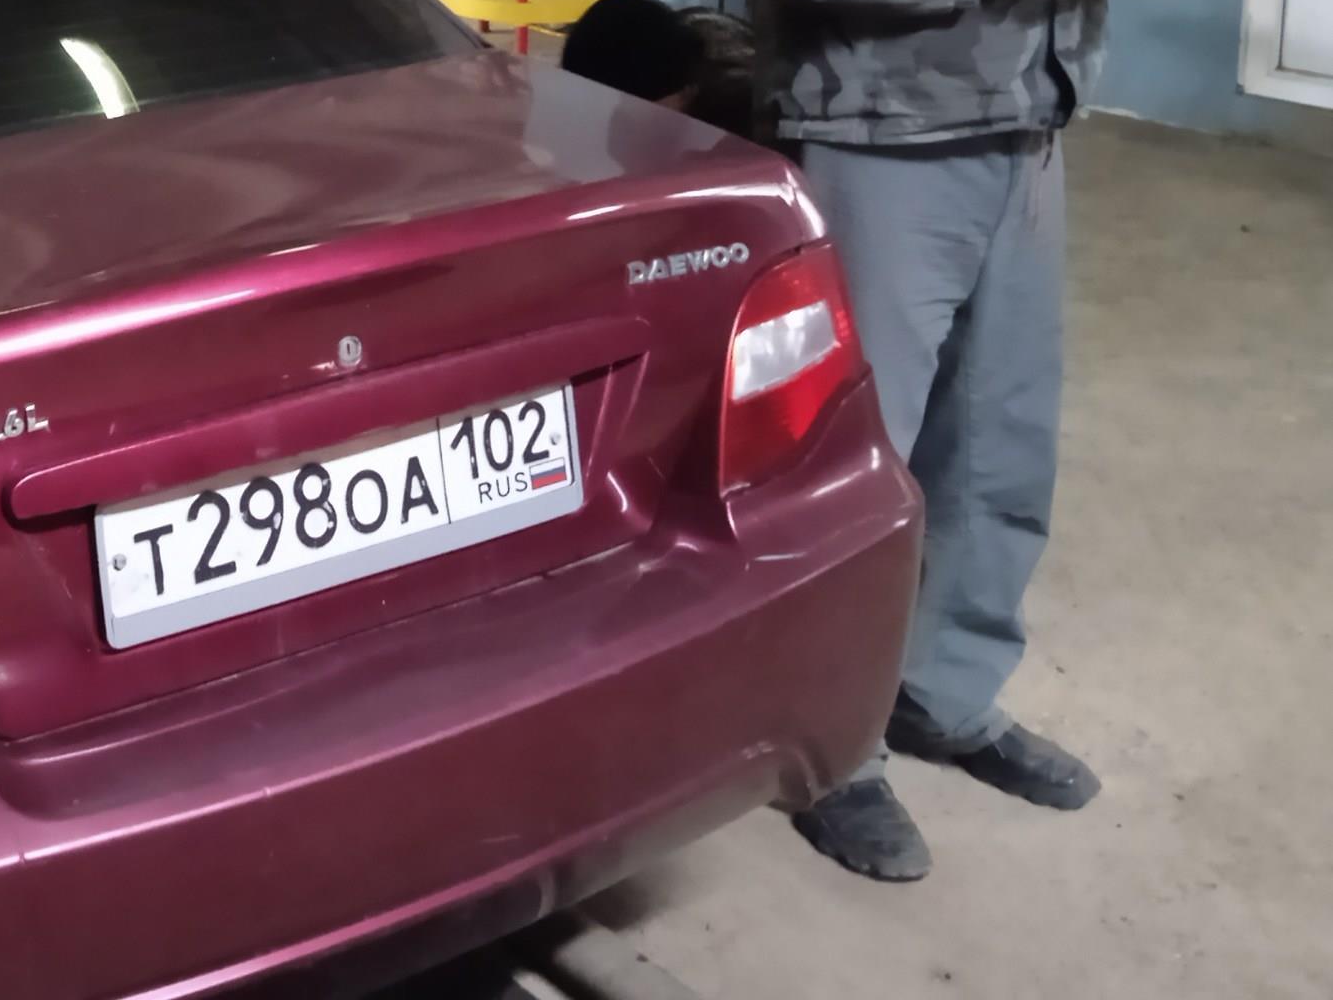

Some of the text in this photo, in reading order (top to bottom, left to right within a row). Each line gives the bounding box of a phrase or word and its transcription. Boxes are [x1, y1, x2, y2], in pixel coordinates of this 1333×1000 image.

[627, 242, 750, 285] DAEWOO
[133, 400, 550, 596] Т298ОА 102
[478, 471, 528, 504] RUS
